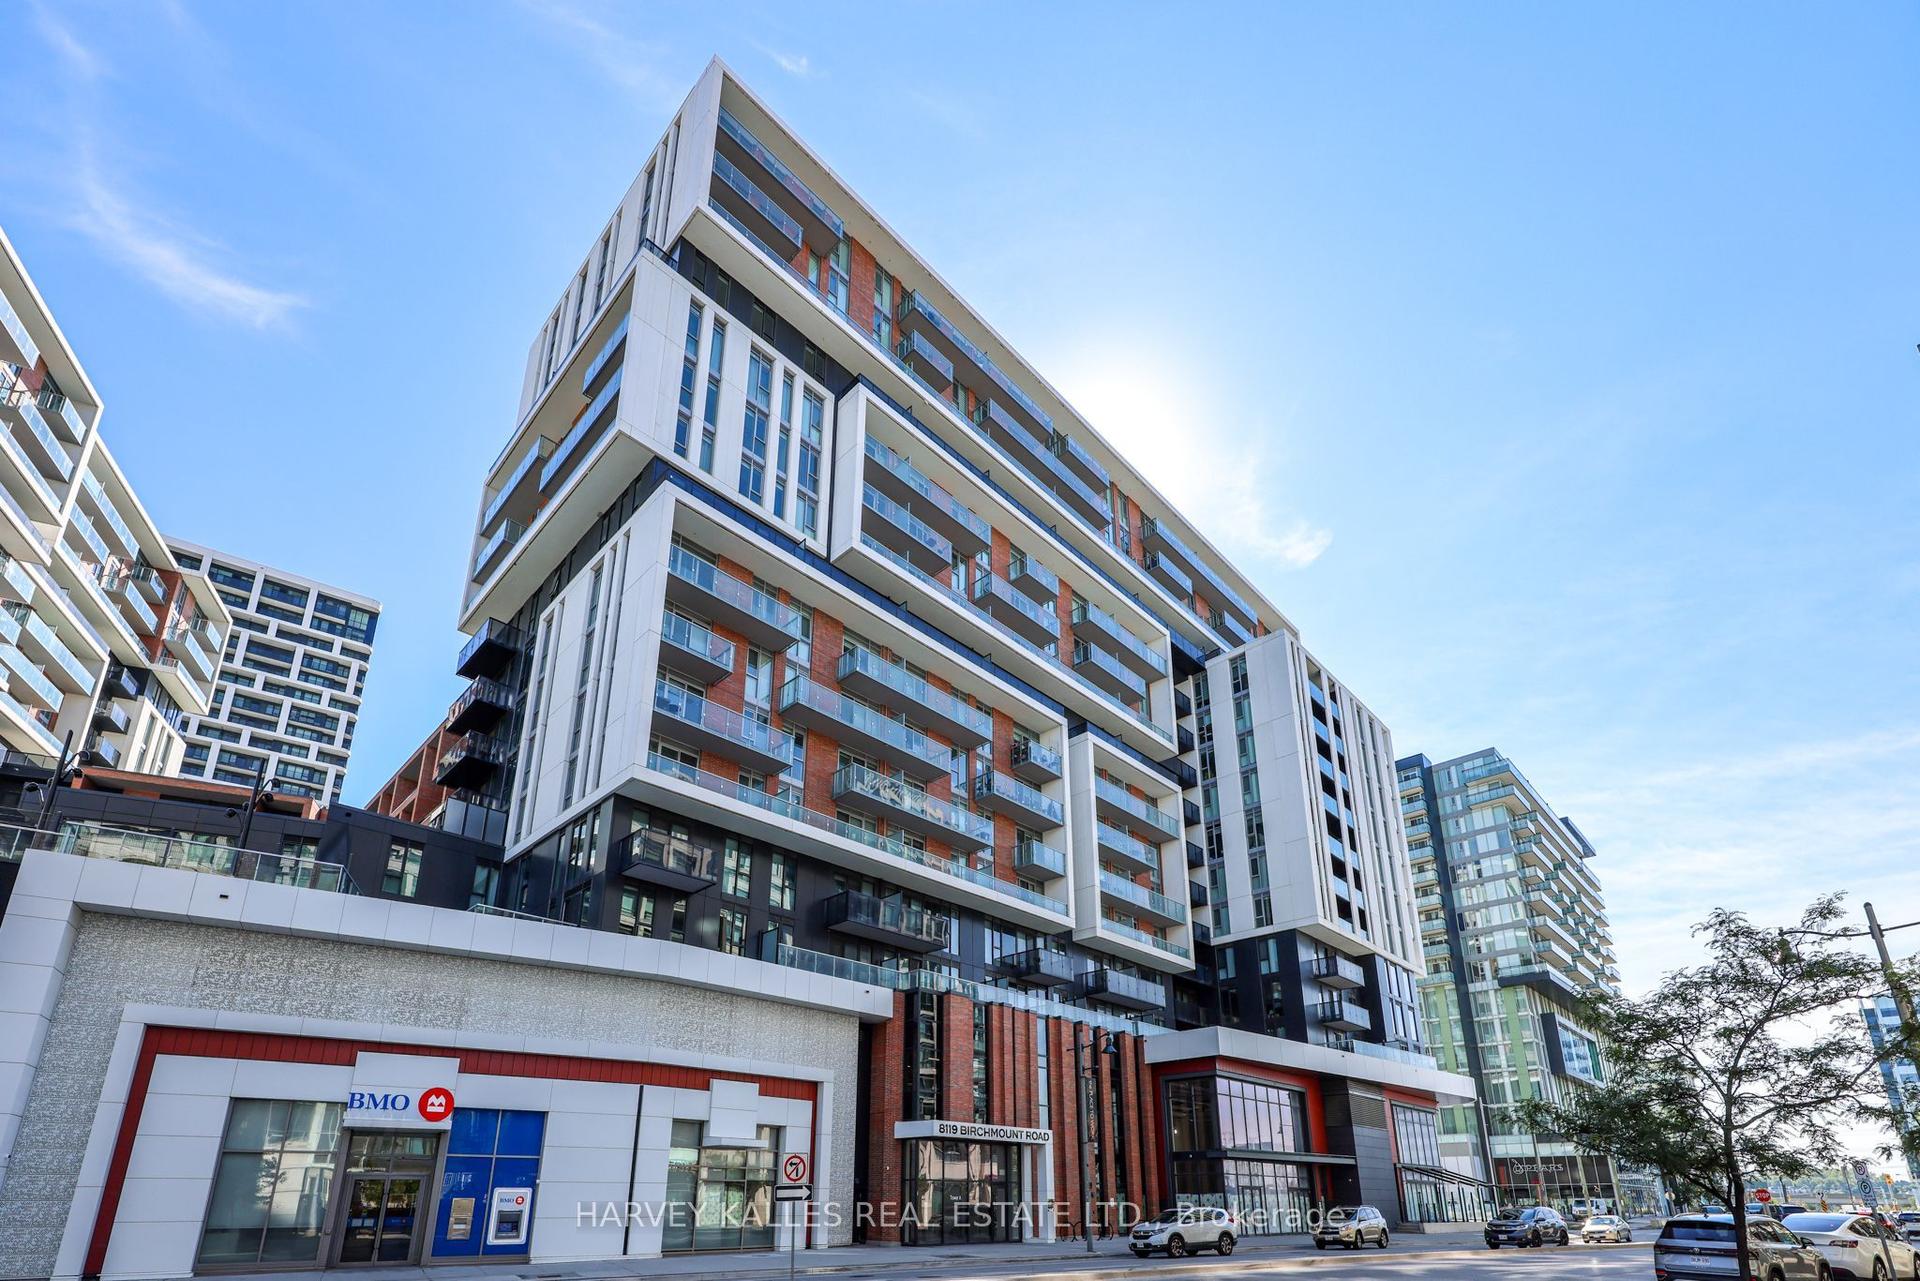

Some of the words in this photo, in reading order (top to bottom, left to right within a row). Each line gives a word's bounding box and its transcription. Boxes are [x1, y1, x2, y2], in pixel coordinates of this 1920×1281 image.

[348, 1092, 410, 1111] BMO
[938, 1123, 958, 1135] 8119
[960, 1125, 1024, 1140] BIRCHMOUNT
[1025, 1131, 1050, 1142] ROAD
